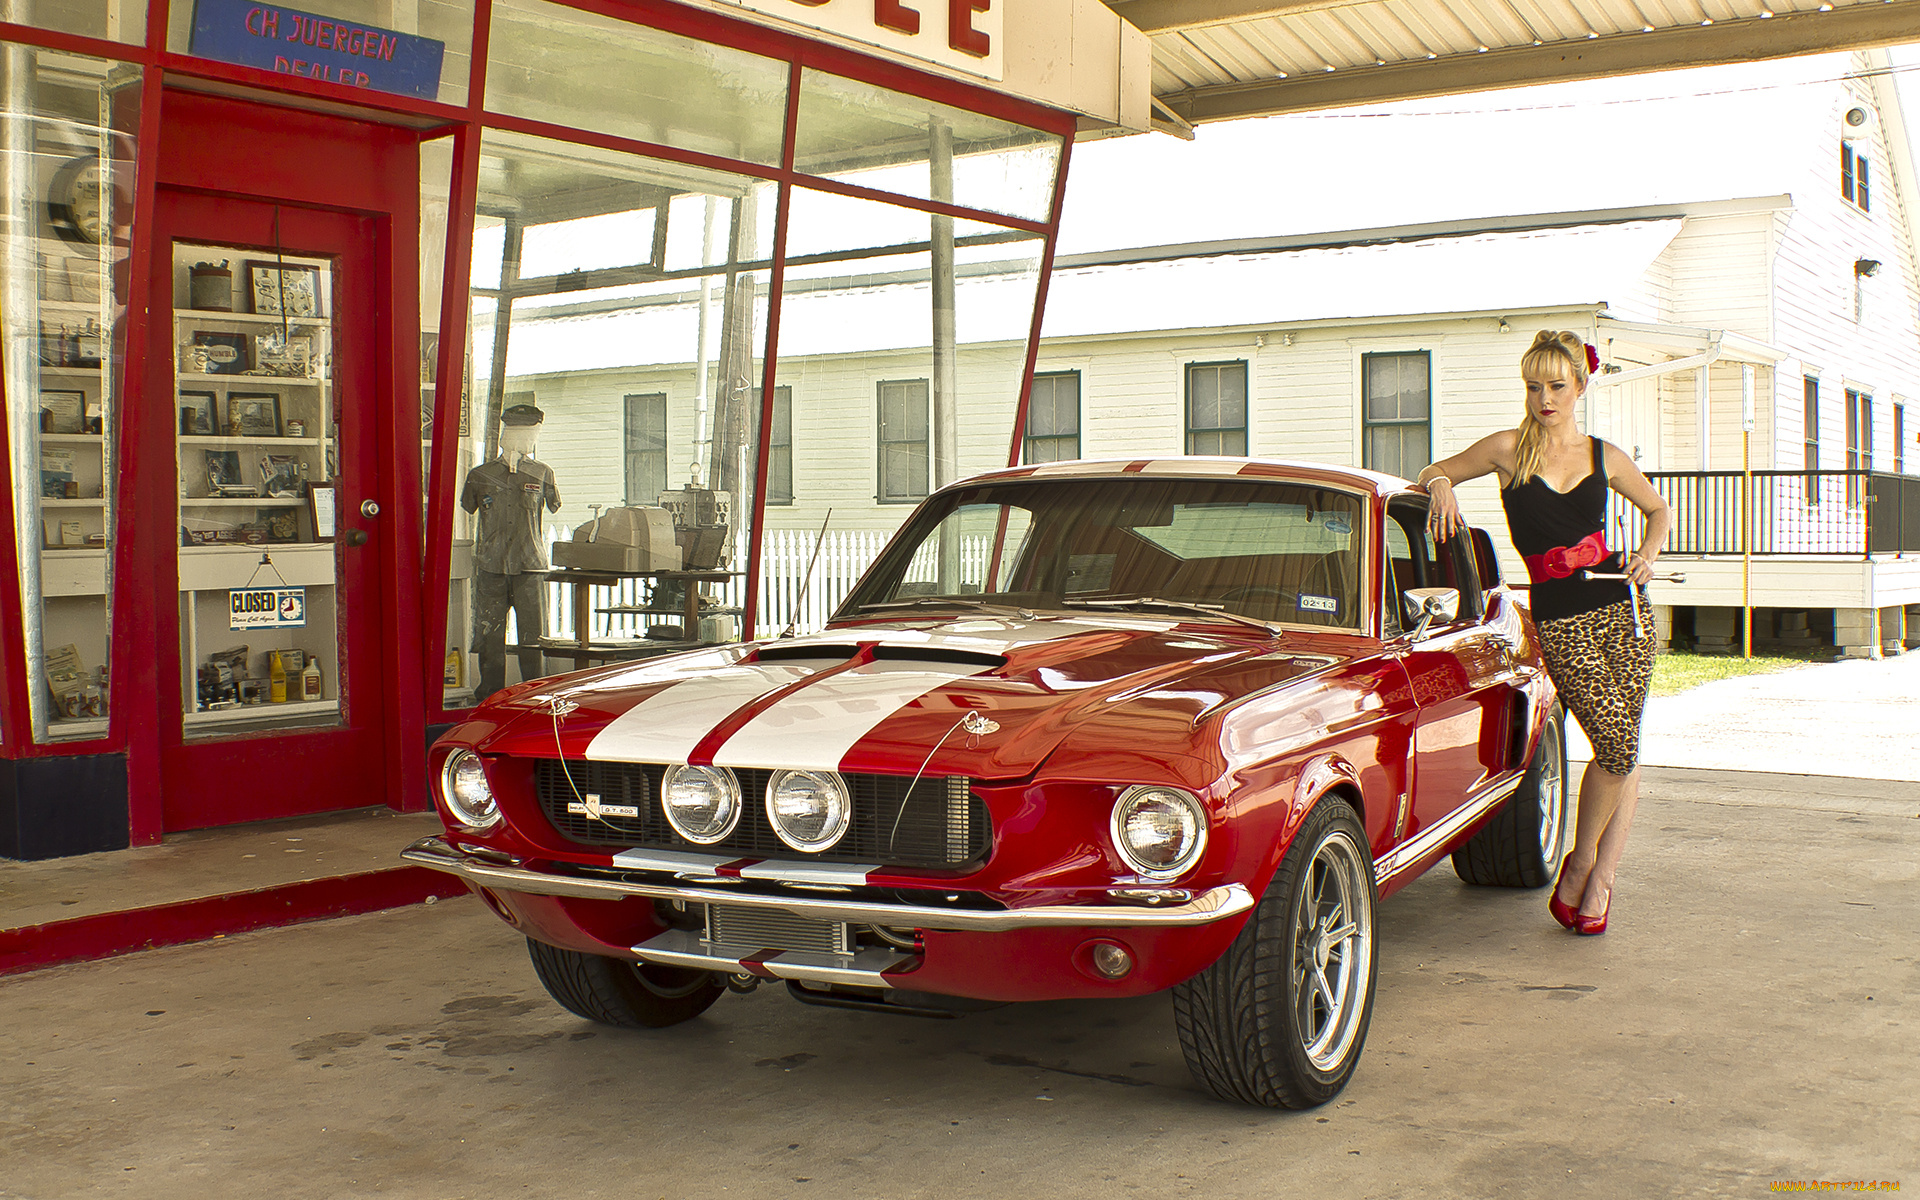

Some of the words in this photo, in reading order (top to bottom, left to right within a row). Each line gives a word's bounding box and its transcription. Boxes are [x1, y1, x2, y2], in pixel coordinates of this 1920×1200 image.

[286, 14, 398, 62] JUERGEN
[231, 591, 276, 613] CLOSED
[247, 615, 258, 623] Call
